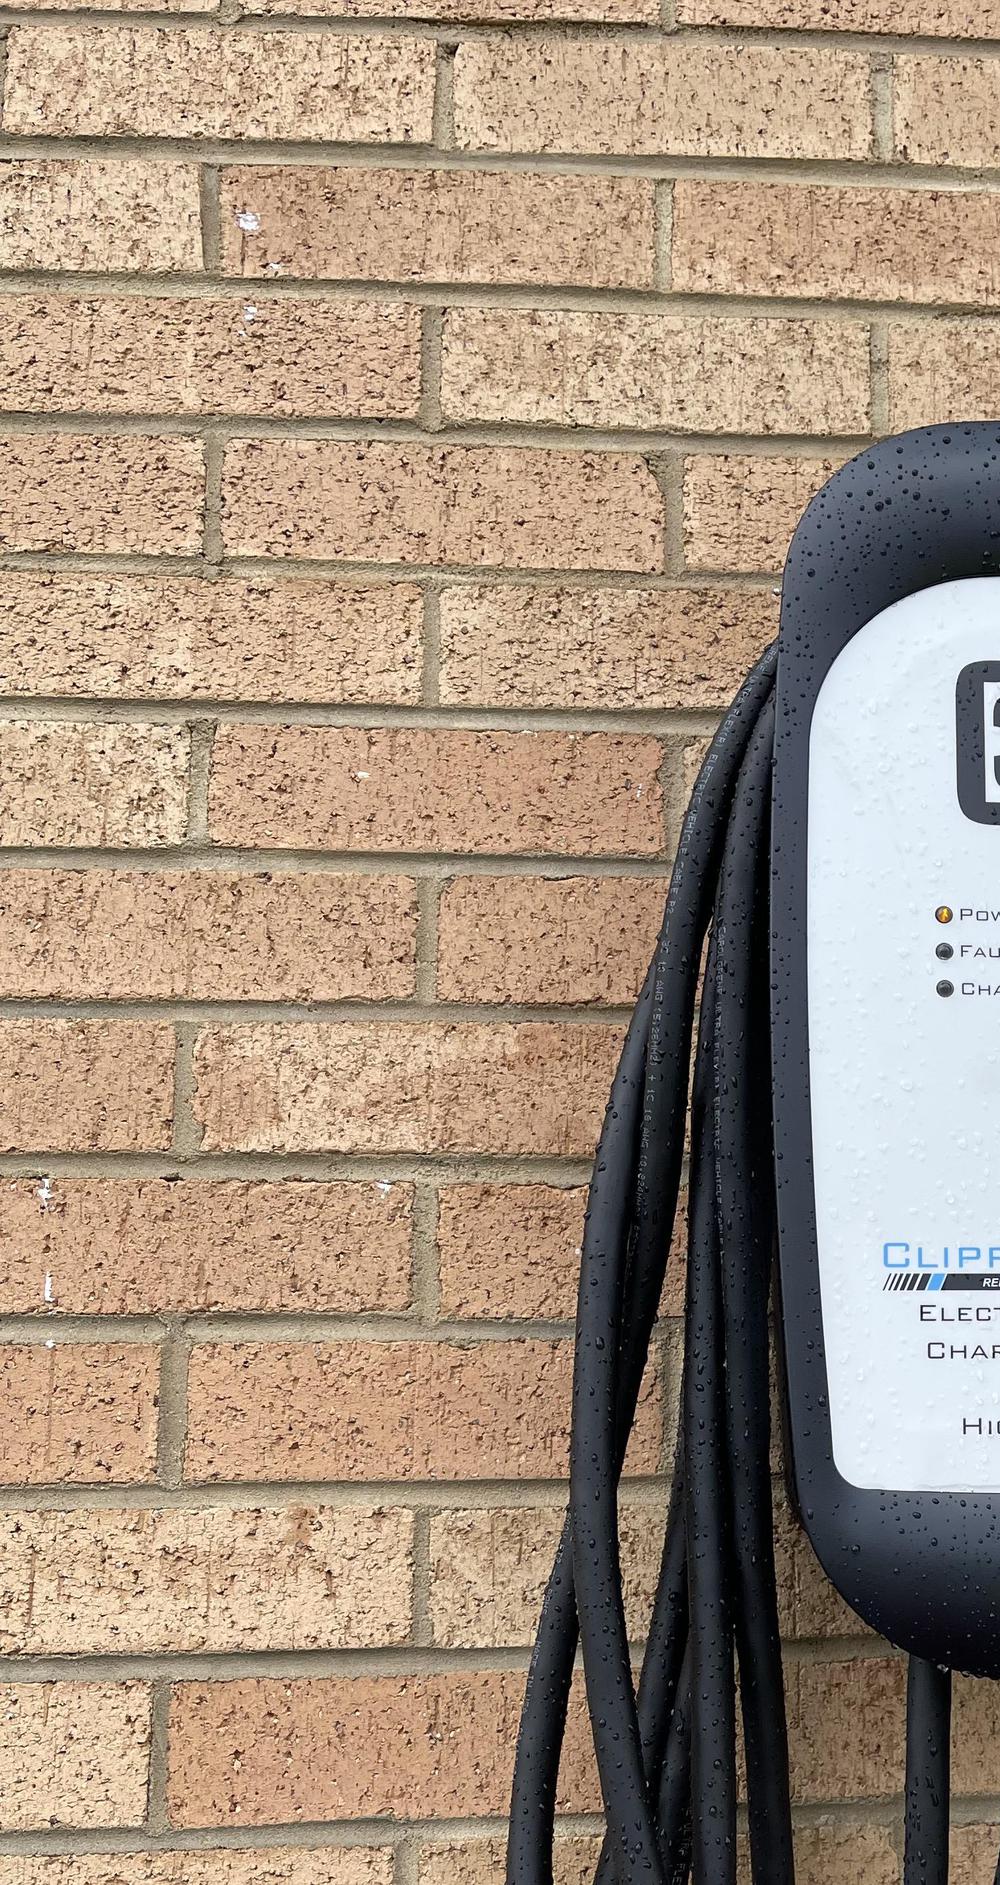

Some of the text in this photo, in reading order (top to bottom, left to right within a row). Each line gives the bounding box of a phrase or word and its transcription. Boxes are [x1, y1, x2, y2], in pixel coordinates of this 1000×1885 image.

[693, 753, 718, 803] ELECTRIC
[680, 809, 698, 855] VEHICLE
[669, 863, 685, 896] CABLE
[654, 980, 665, 1001] AWG
